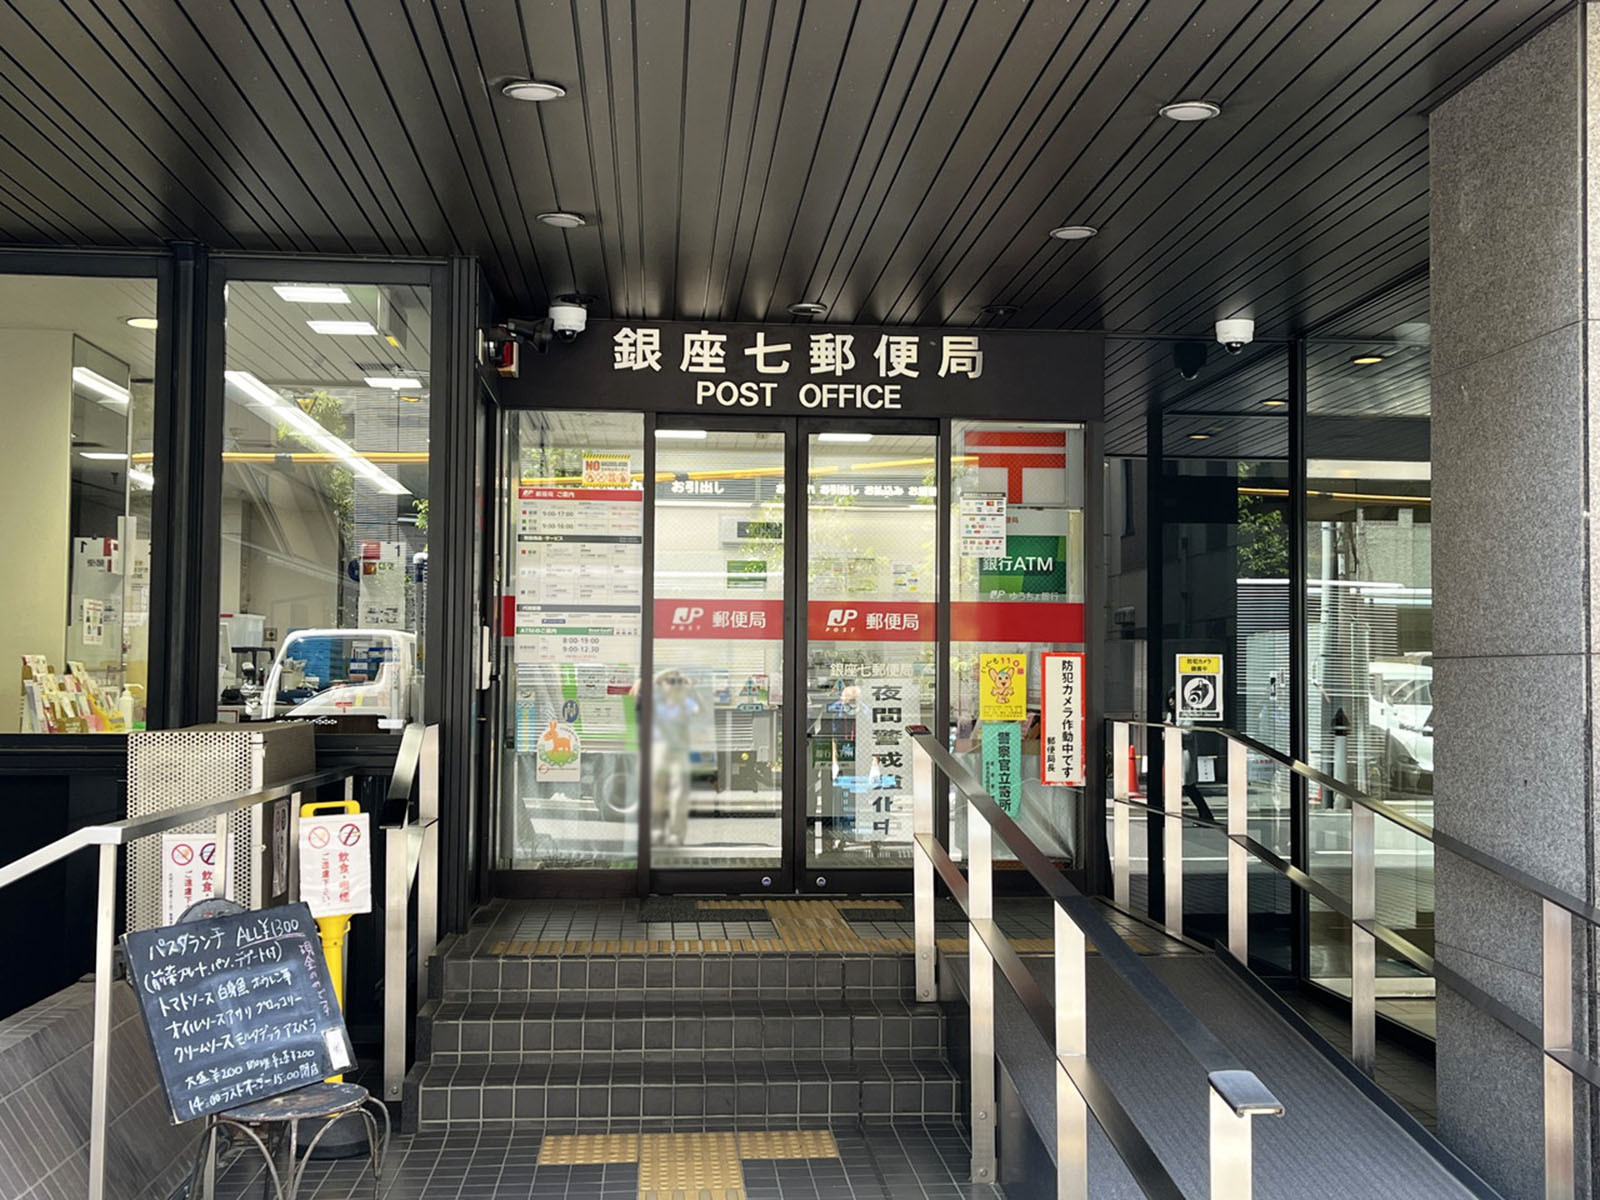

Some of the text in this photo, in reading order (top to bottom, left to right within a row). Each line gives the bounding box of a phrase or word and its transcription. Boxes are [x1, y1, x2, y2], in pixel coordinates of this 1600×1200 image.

[613, 327, 984, 379] 銀座七郵便局
[696, 380, 902, 410] POST OFFICE
[982, 556, 1053, 572] 銀行ATM
[711, 610, 767, 629] 郵便局
[865, 613, 920, 631] 郵便局
[1061, 660, 1074, 779] 防犯カメラ作動中です
[998, 732, 1011, 811] 警察官立寄所
[159, 990, 215, 1017] トマトソース
[217, 981, 250, 1001] 白身魚
